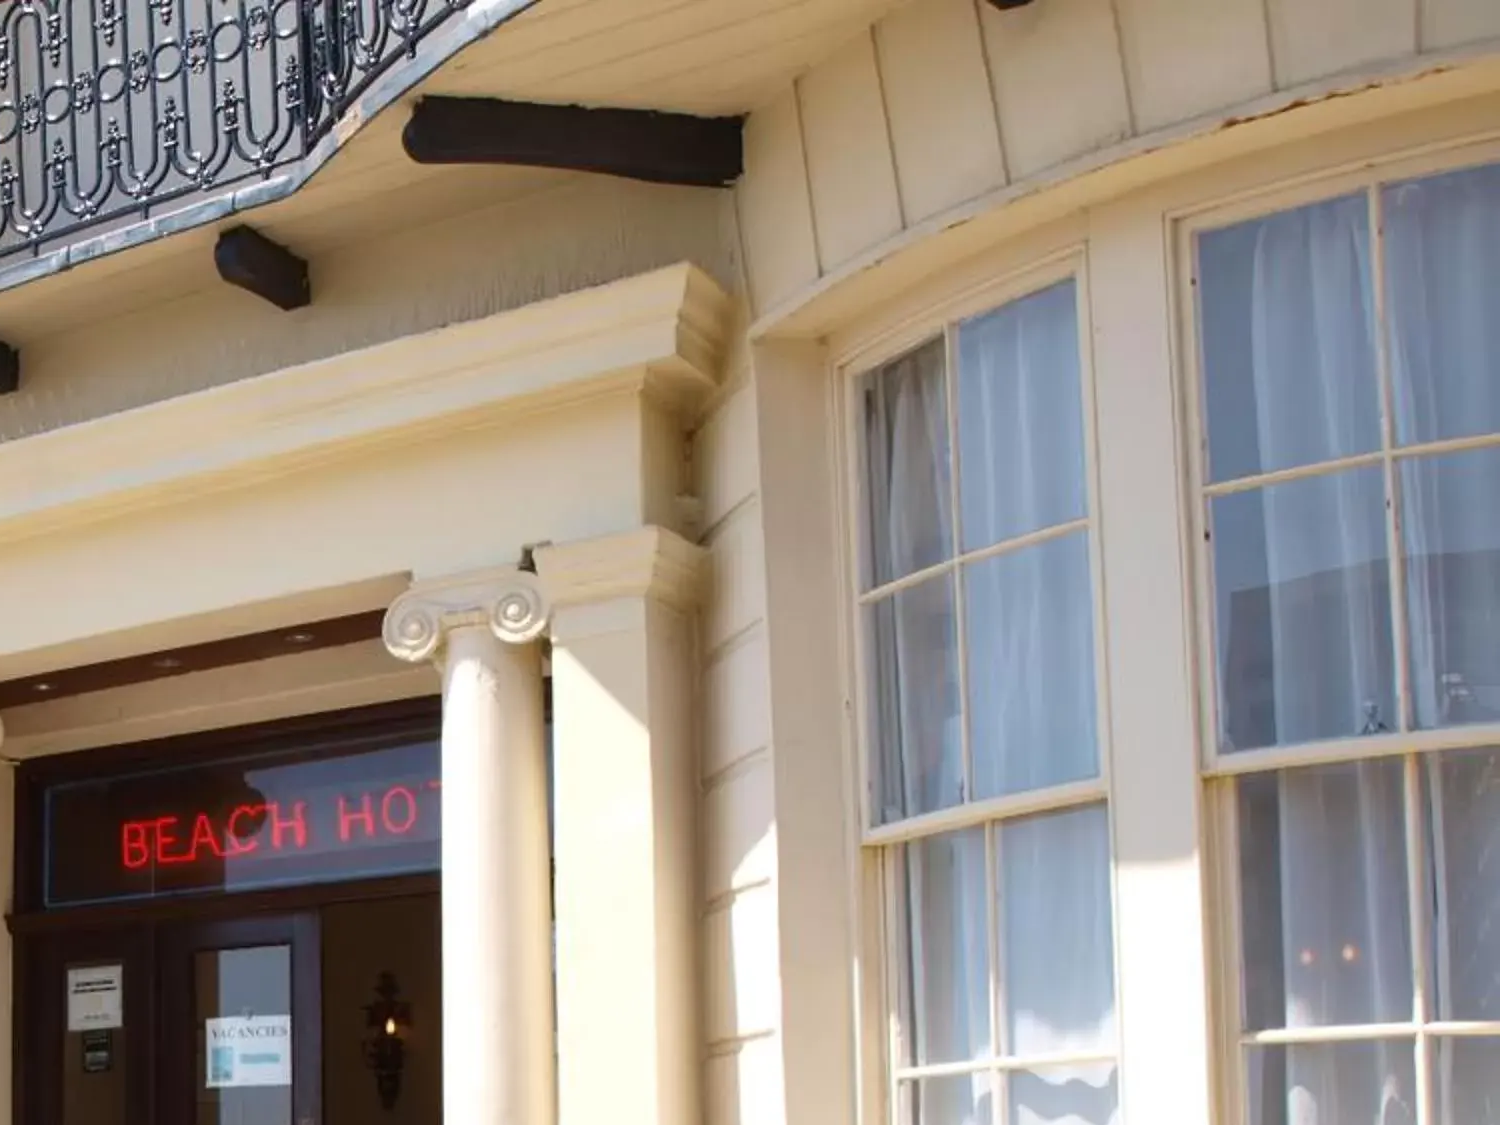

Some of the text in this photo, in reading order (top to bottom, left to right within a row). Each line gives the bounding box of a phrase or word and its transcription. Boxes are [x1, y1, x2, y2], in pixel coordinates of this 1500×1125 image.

[122, 779, 442, 869] BEACH HO
[211, 1025, 289, 1040] VACANCIES
